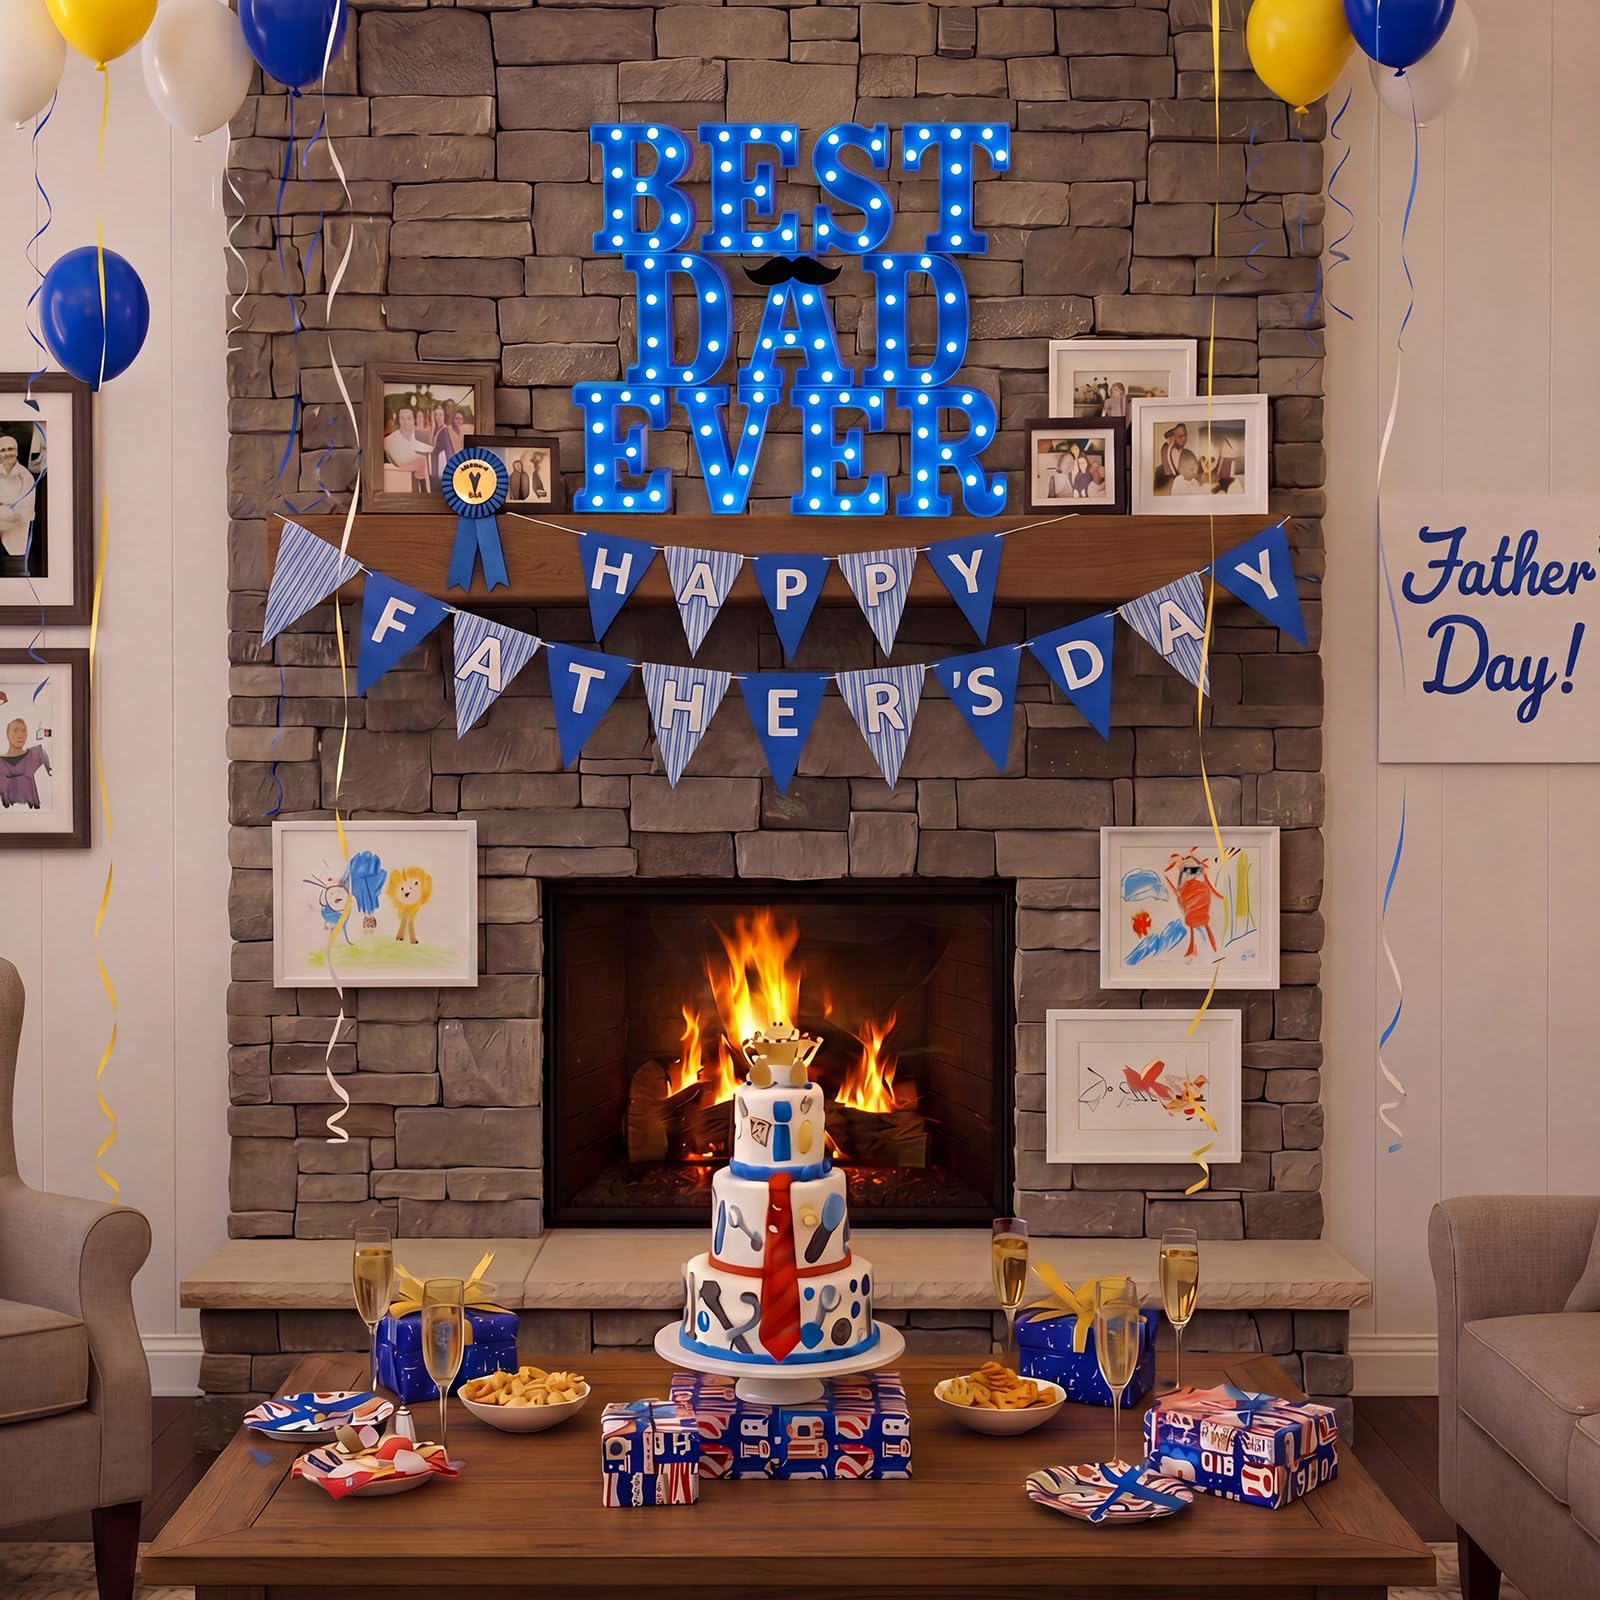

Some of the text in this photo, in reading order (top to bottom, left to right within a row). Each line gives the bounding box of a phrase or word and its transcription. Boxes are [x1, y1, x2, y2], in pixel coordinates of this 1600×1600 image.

[590, 122, 1010, 254] BEST
[623, 252, 971, 388] DAD
[571, 381, 1008, 517] EVER
[591, 547, 983, 611] HAPPY
[1402, 526, 1600, 604] Father
[371, 548, 1279, 737] FATHER'S DAY
[1423, 614, 1585, 723] Day!
